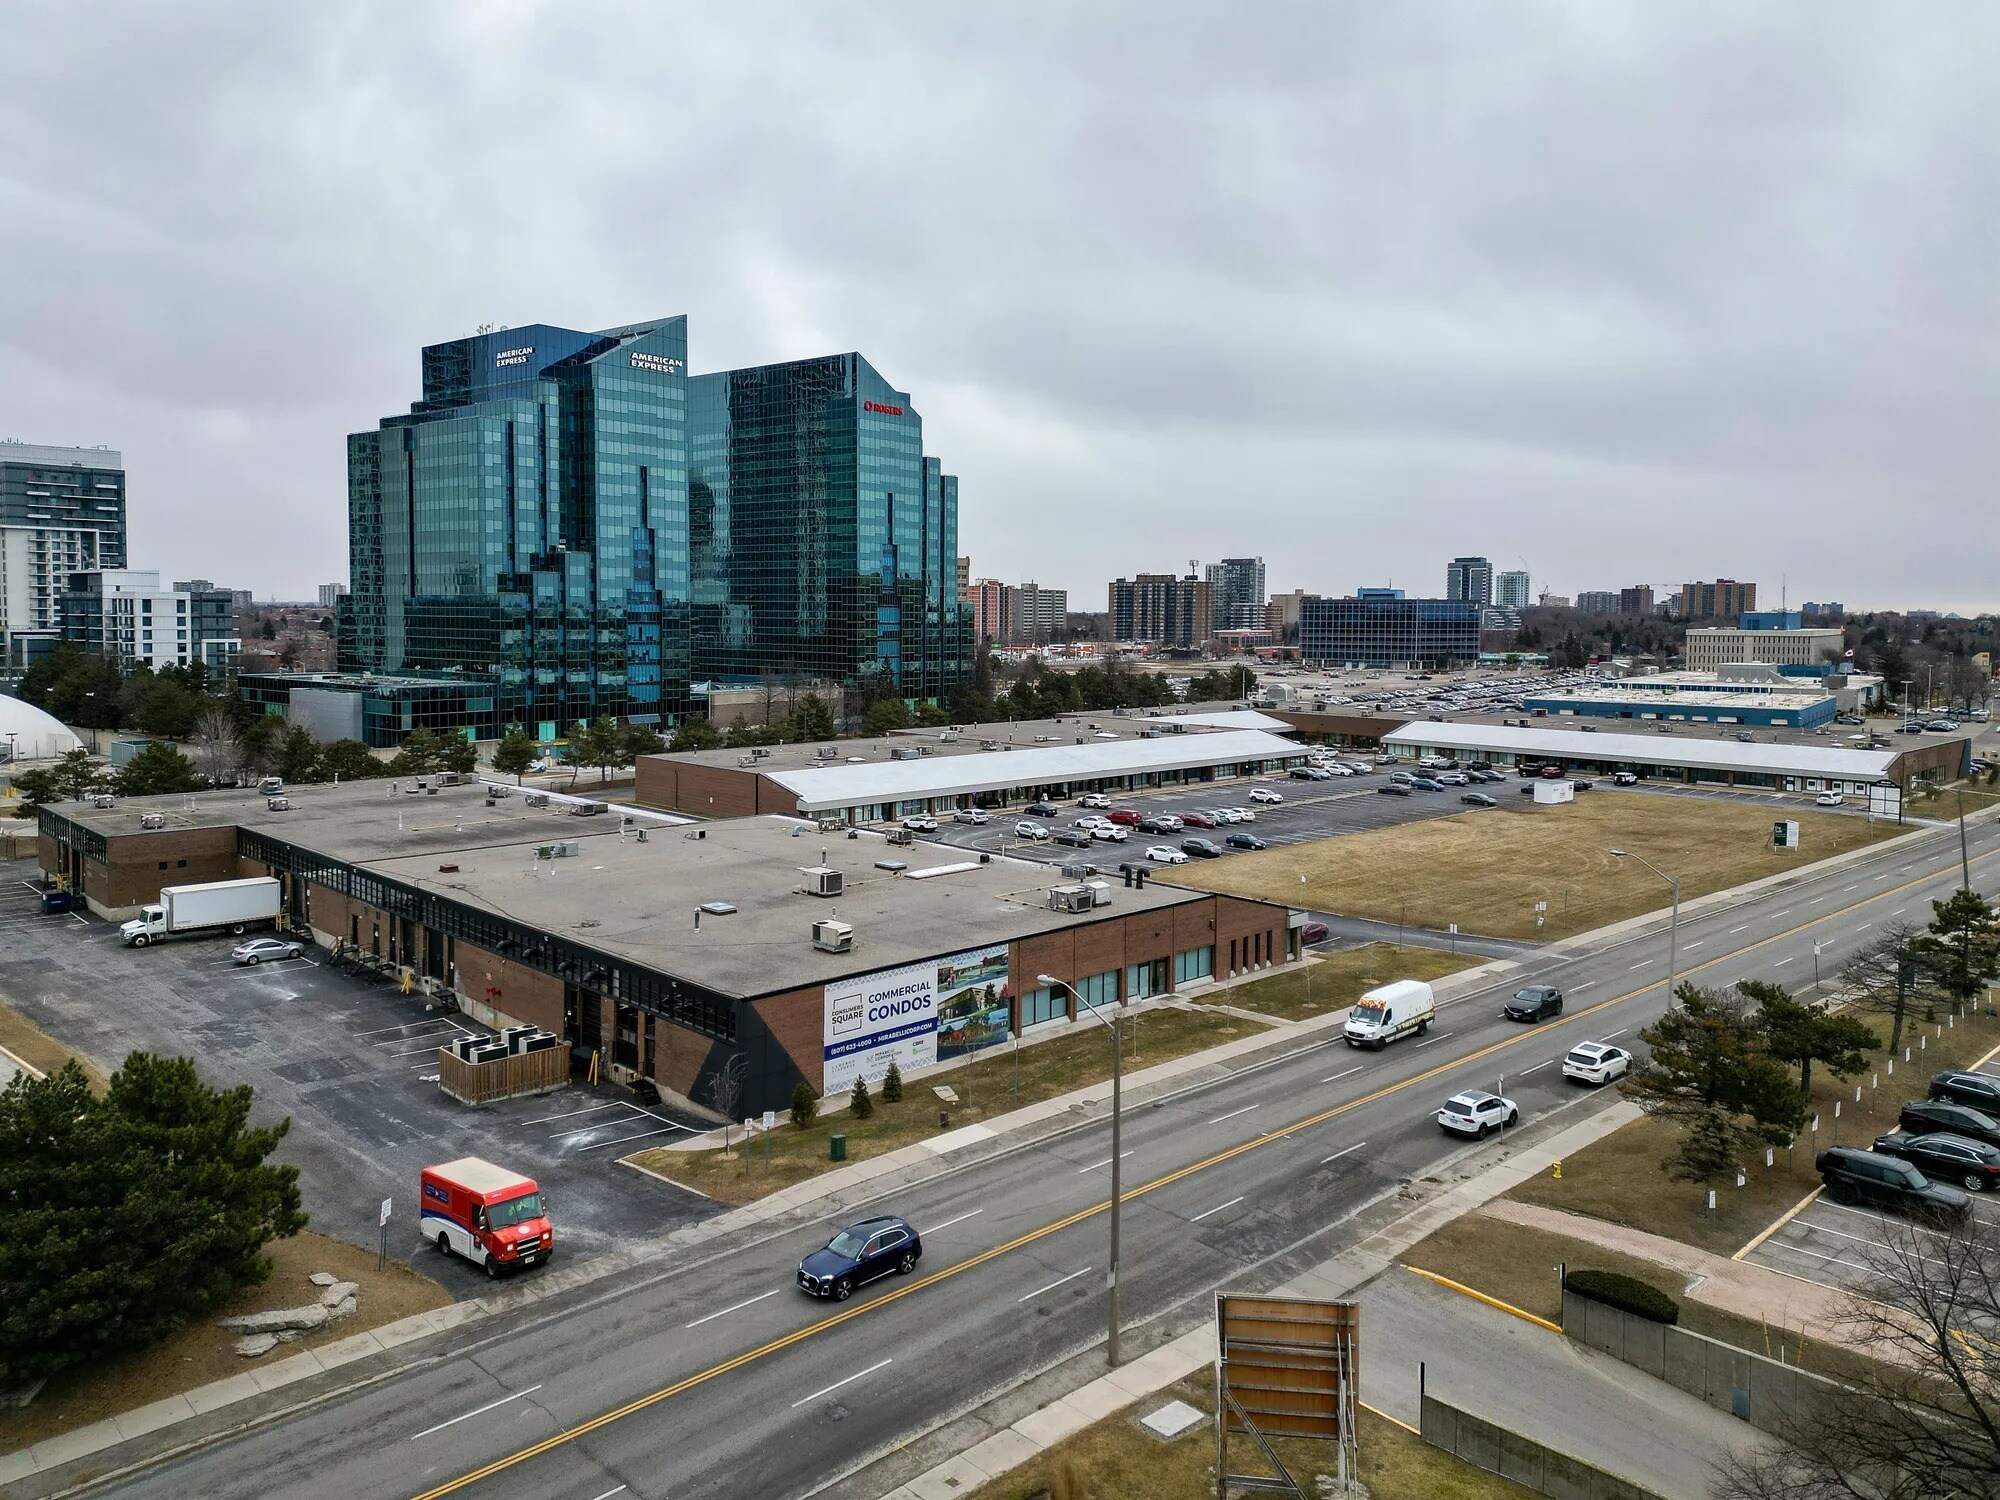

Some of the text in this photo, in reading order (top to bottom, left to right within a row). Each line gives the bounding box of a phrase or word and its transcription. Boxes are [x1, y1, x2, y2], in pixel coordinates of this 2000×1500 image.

[496, 347, 533, 360] AMERICAN
[631, 352, 683, 367] AMERICAN
[496, 355, 527, 367] EXPRESS
[631, 360, 675, 373] EXPRESS
[873, 403, 903, 416] ROGERS
[868, 982, 931, 1004] COMMERCIAL
[831, 1004, 863, 1017] CONSUMERS
[868, 994, 931, 1022] CONDOS
[831, 1010, 863, 1025] SQUARE
[878, 1023, 932, 1042] MIRABELLICORP.COM
